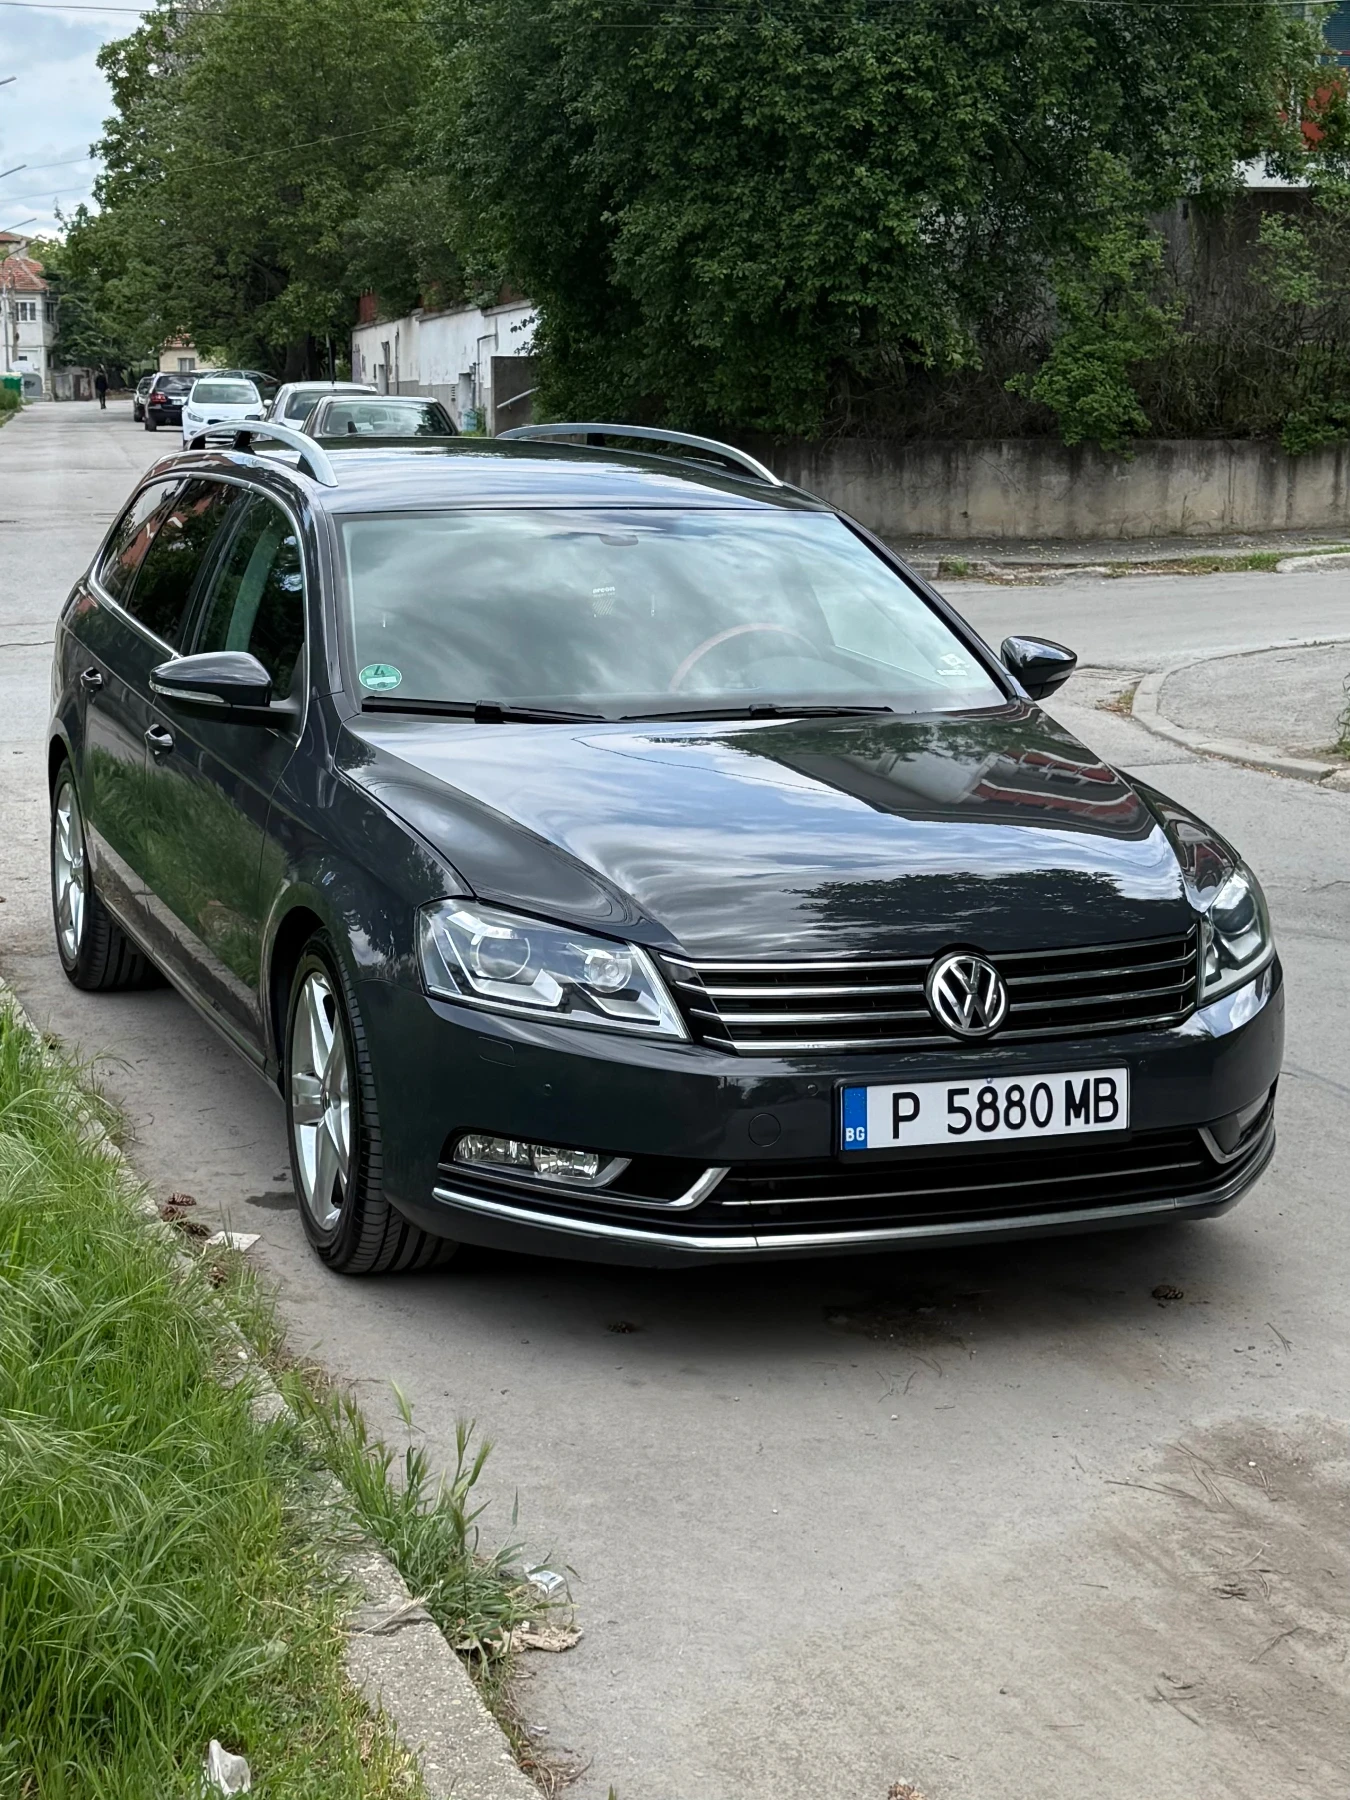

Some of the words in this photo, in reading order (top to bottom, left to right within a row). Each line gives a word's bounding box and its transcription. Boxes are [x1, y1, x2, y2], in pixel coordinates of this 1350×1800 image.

[373, 665, 386, 677] 4
[892, 1091, 920, 1139] P
[947, 1082, 1053, 1135] 5880
[1064, 1076, 1119, 1127] MB
[845, 1126, 865, 1142] BG
